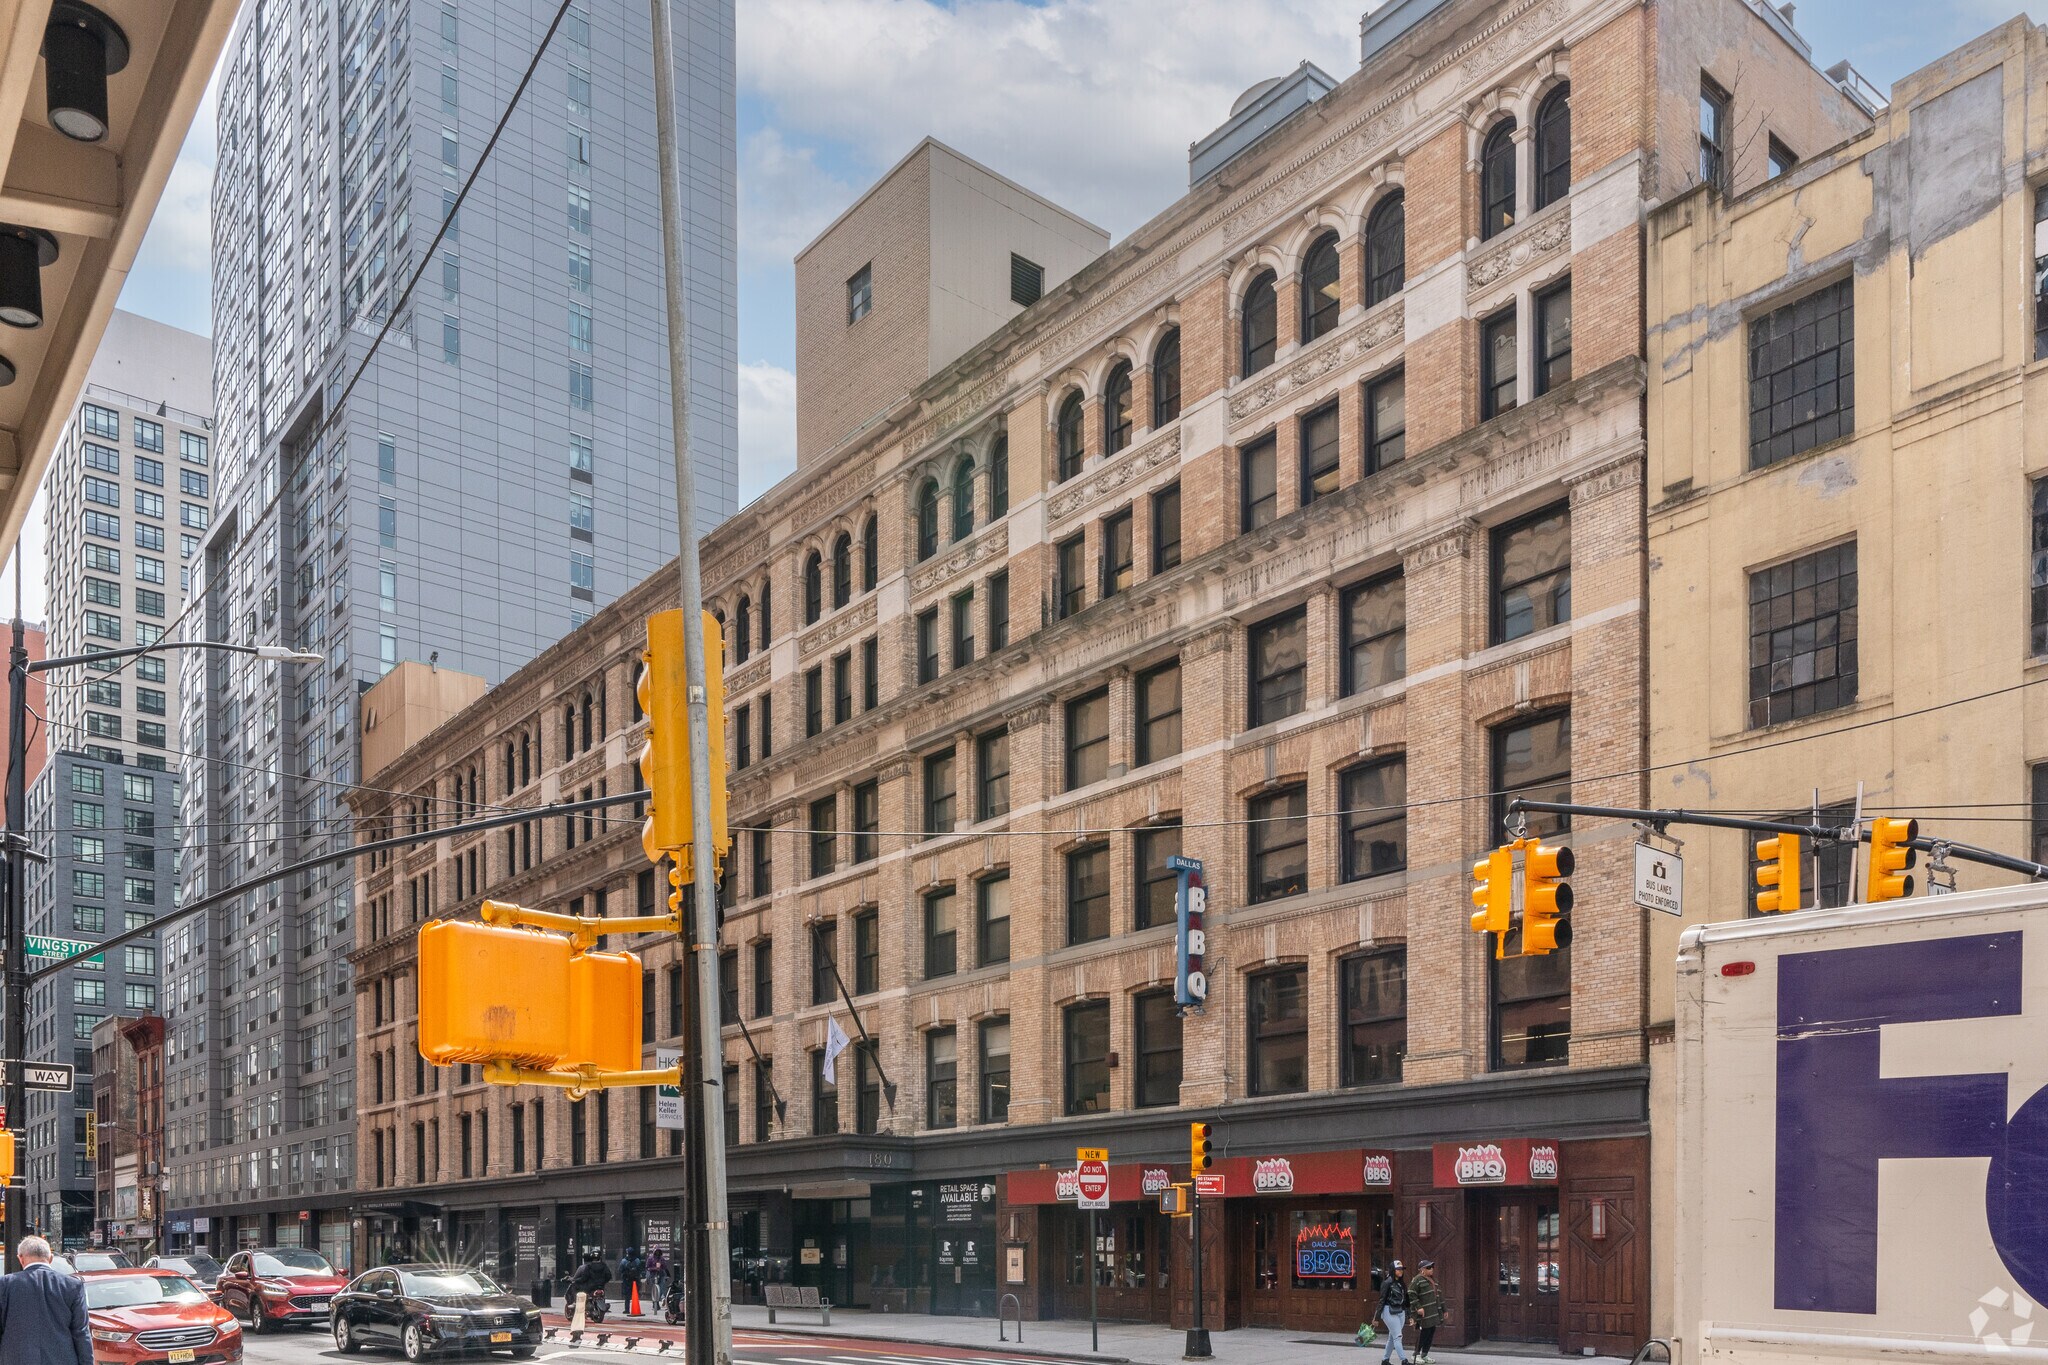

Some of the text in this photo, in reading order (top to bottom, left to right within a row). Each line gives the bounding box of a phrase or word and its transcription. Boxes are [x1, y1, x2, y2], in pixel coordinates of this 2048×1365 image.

[1176, 858, 1201, 870] DALLAS
[1646, 879, 1672, 895] BUS LANES
[1638, 890, 1678, 910] PHOTO ENFORCED
[1188, 886, 1206, 1000] BBQ
[42, 950, 69, 958] STREET
[35, 1071, 64, 1082] WAY
[1774, 930, 2048, 1314] F
[869, 1152, 892, 1165] 180
[1085, 1150, 1100, 1158] NEW
[1461, 1160, 1502, 1178] BBQ
[1534, 1159, 1554, 1173] BBQ
[1258, 1172, 1290, 1187] BBQ
[1367, 1167, 1389, 1180] BBQ
[940, 1183, 978, 1193] RETAIL SPACE
[1085, 1184, 1101, 1192] ENTER
[941, 1192, 978, 1203] AVAILABLE
[1299, 1250, 1351, 1274] BBQ
